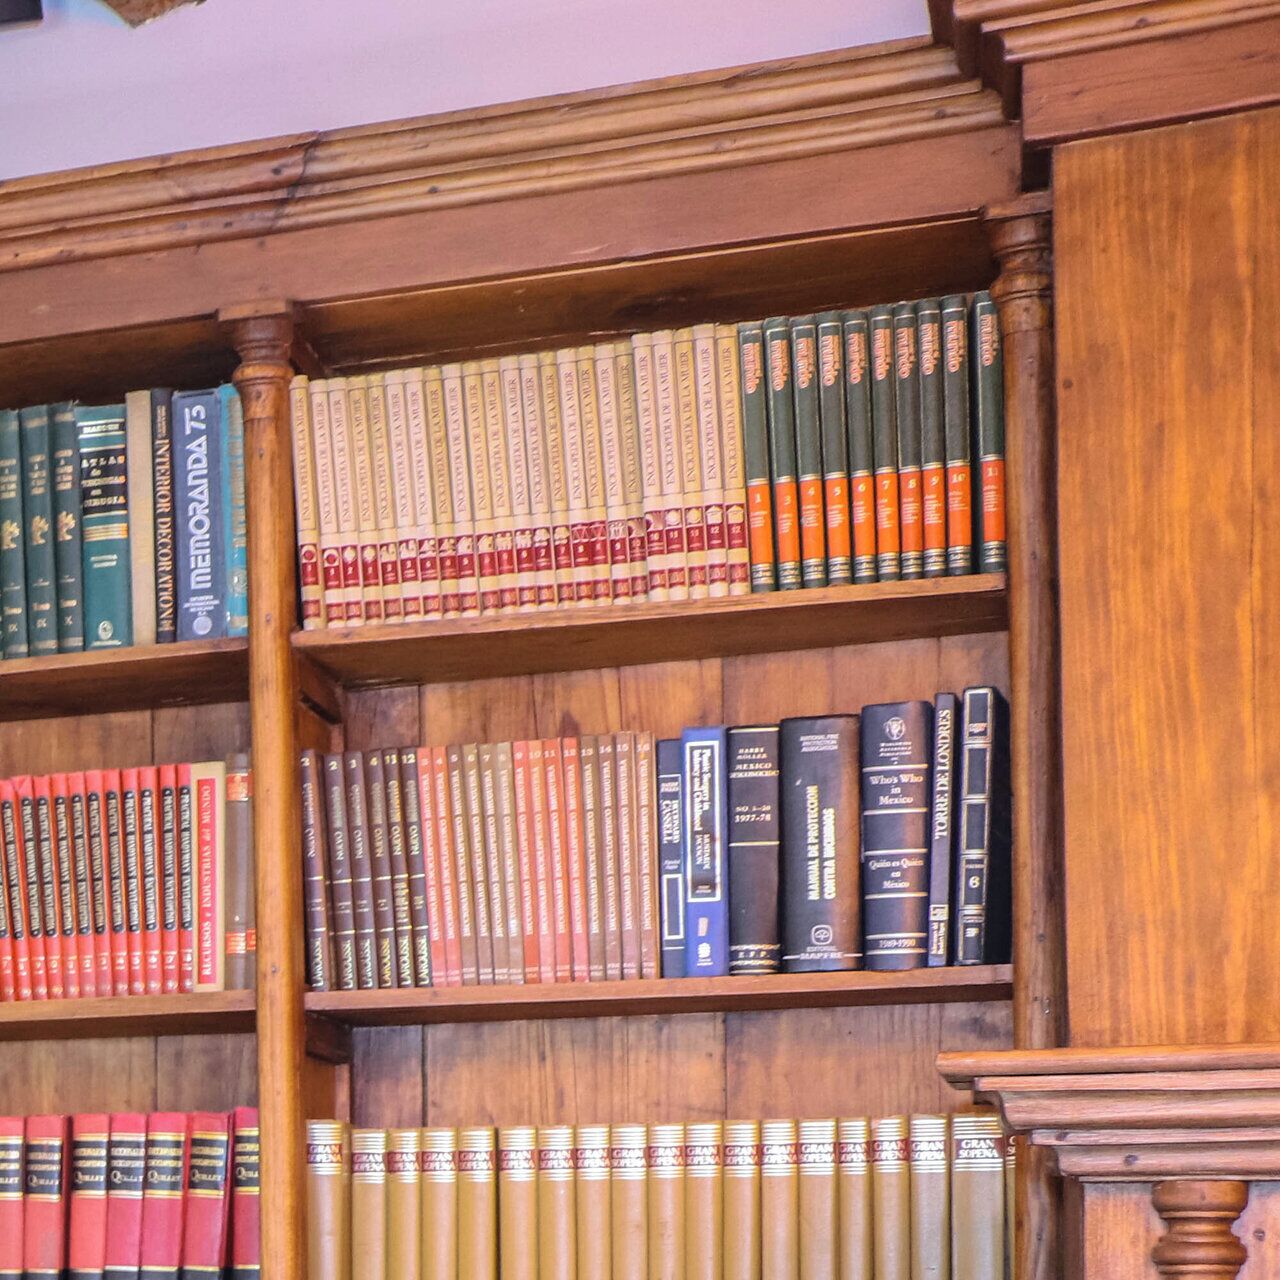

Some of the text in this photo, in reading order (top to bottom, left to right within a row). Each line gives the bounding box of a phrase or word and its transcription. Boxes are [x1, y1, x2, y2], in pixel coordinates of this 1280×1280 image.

[700, 348, 710, 379] MUJER
[721, 348, 731, 379] MUJER
[796, 338, 809, 389] mundo
[820, 335, 835, 387] mundo
[847, 333, 861, 384] mundo
[873, 328, 886, 380] mundo
[896, 328, 910, 379] mundo
[920, 323, 934, 375] mundo
[945, 320, 959, 373] mundo
[980, 314, 993, 366] mundo
[639, 355, 649, 386] MUJER
[658, 352, 669, 384] MUJER
[679, 351, 689, 382] MUJER
[743, 343, 756, 394] mundo
[770, 340, 782, 391] mundo
[184, 405, 207, 435] 75
[81, 455, 125, 468] ATLAS
[154, 439, 171, 513] INTERIOR
[185, 434, 212, 590] MEMORANDA
[157, 517, 174, 619] DECORATION
[869, 773, 924, 786] Who's Who
[878, 794, 913, 805] Mexico
[934, 709, 951, 840] TORRE DE LONDRES
[200, 784, 211, 828] MUNDO
[805, 785, 820, 900] MANUAL DE PROTECCION
[201, 846, 211, 908] INDUSTRIAS
[822, 859, 836, 900] CONTRA
[201, 920, 211, 976] RECURSOS
[311, 938, 323, 988] LAROUSSE
[342, 939, 353, 989] LAROUSSE
[399, 935, 411, 985] LAROUSSE
[417, 935, 430, 985] LAROUSSE
[354, 1153, 383, 1163] GRAN
[542, 1149, 571, 1159] GRAN
[613, 1149, 643, 1159] GRAN
[763, 1144, 795, 1154] GRAN
[801, 1143, 833, 1153] GRAN
[912, 1140, 944, 1151] GRAN
[961, 1139, 995, 1149] GRAN
